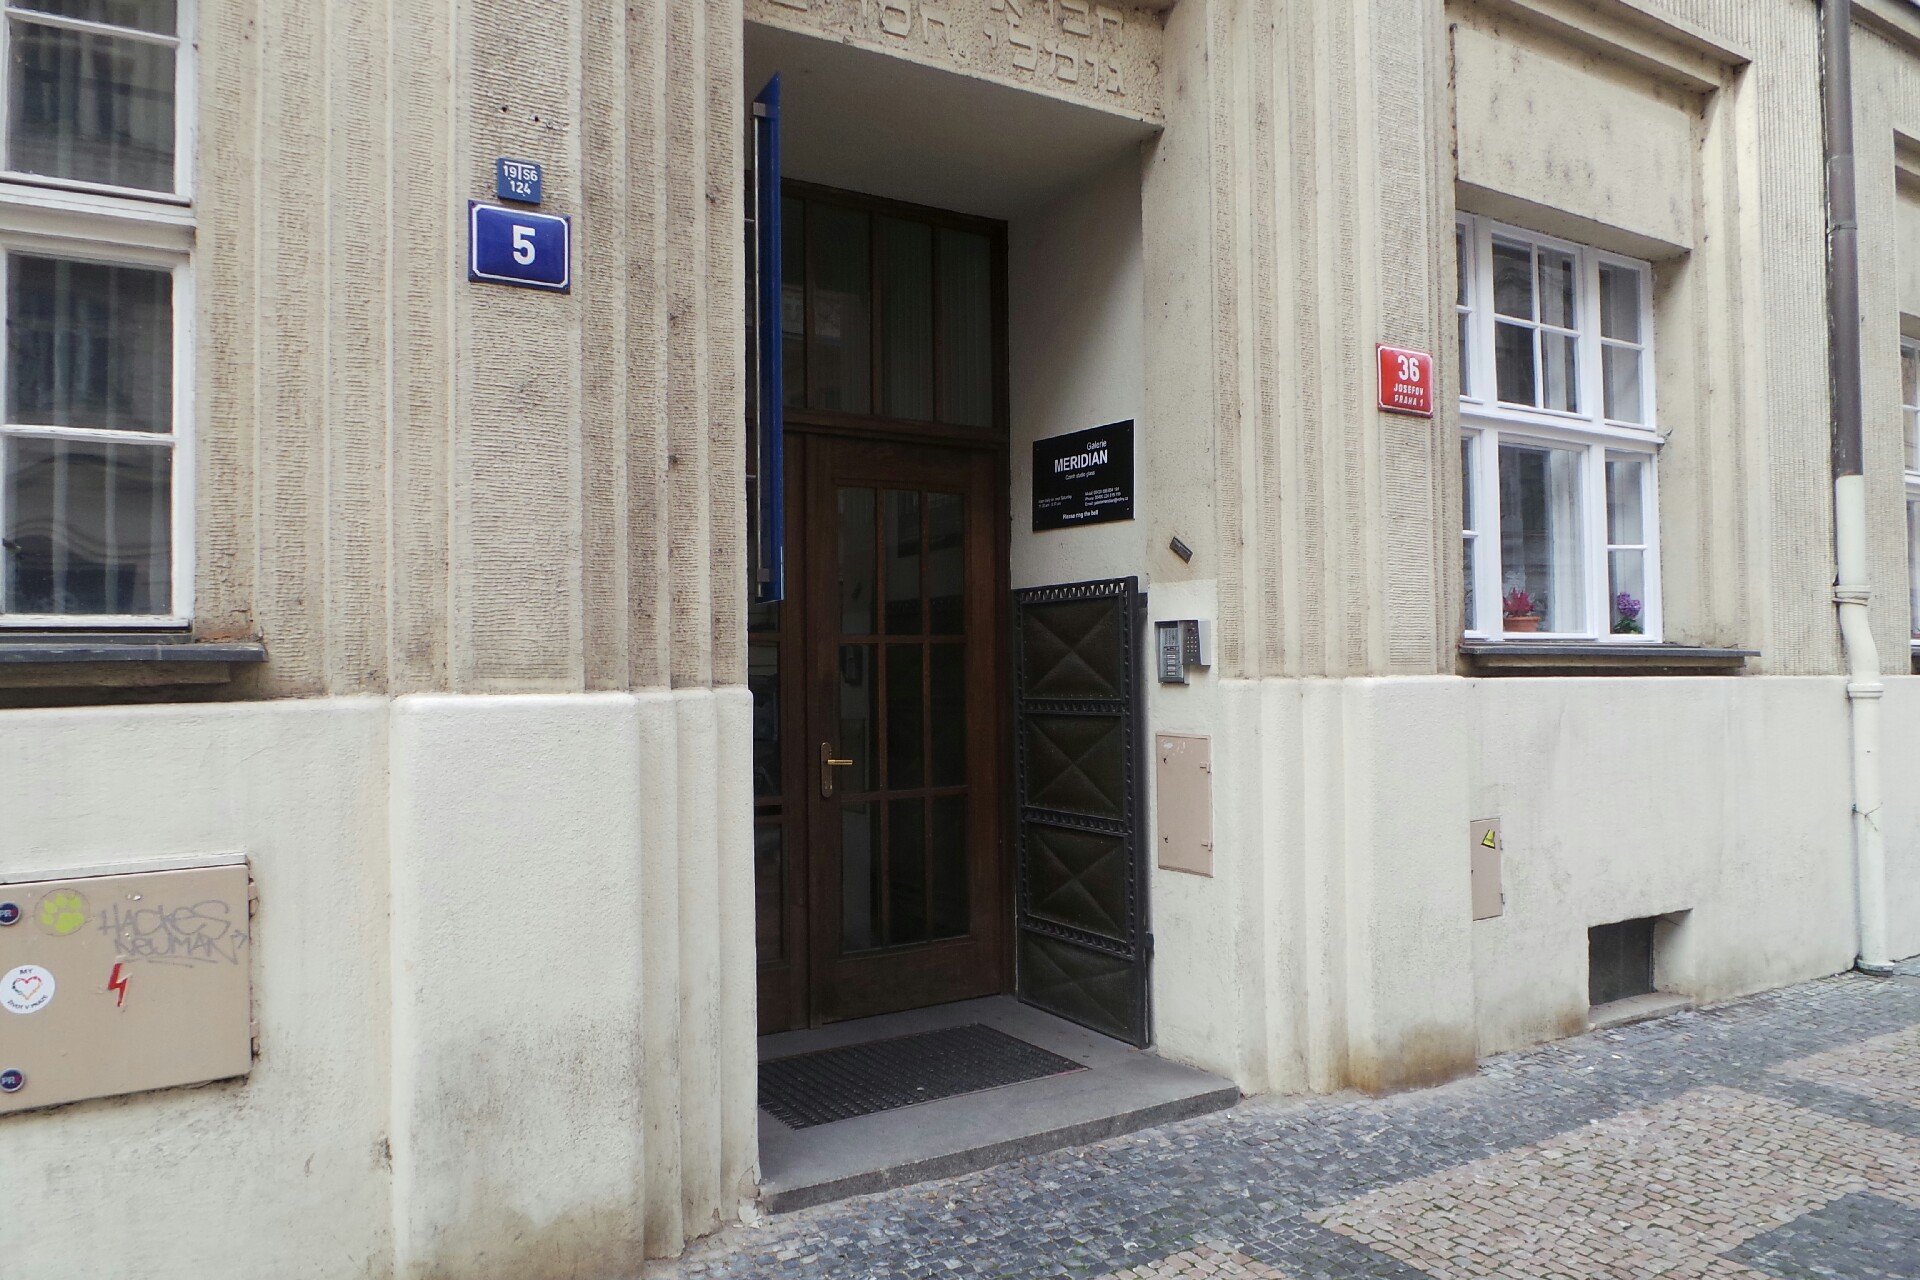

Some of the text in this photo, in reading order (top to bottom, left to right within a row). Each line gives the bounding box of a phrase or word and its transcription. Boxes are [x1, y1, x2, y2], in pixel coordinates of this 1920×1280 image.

[512, 224, 536, 265] 5
[1397, 354, 1420, 382] 36
[1393, 383, 1424, 396] JOSEFOV
[1394, 394, 1424, 407] PRAHA 1
[1086, 438, 1108, 450] Galerie
[1054, 449, 1108, 473] MERIDIAN
